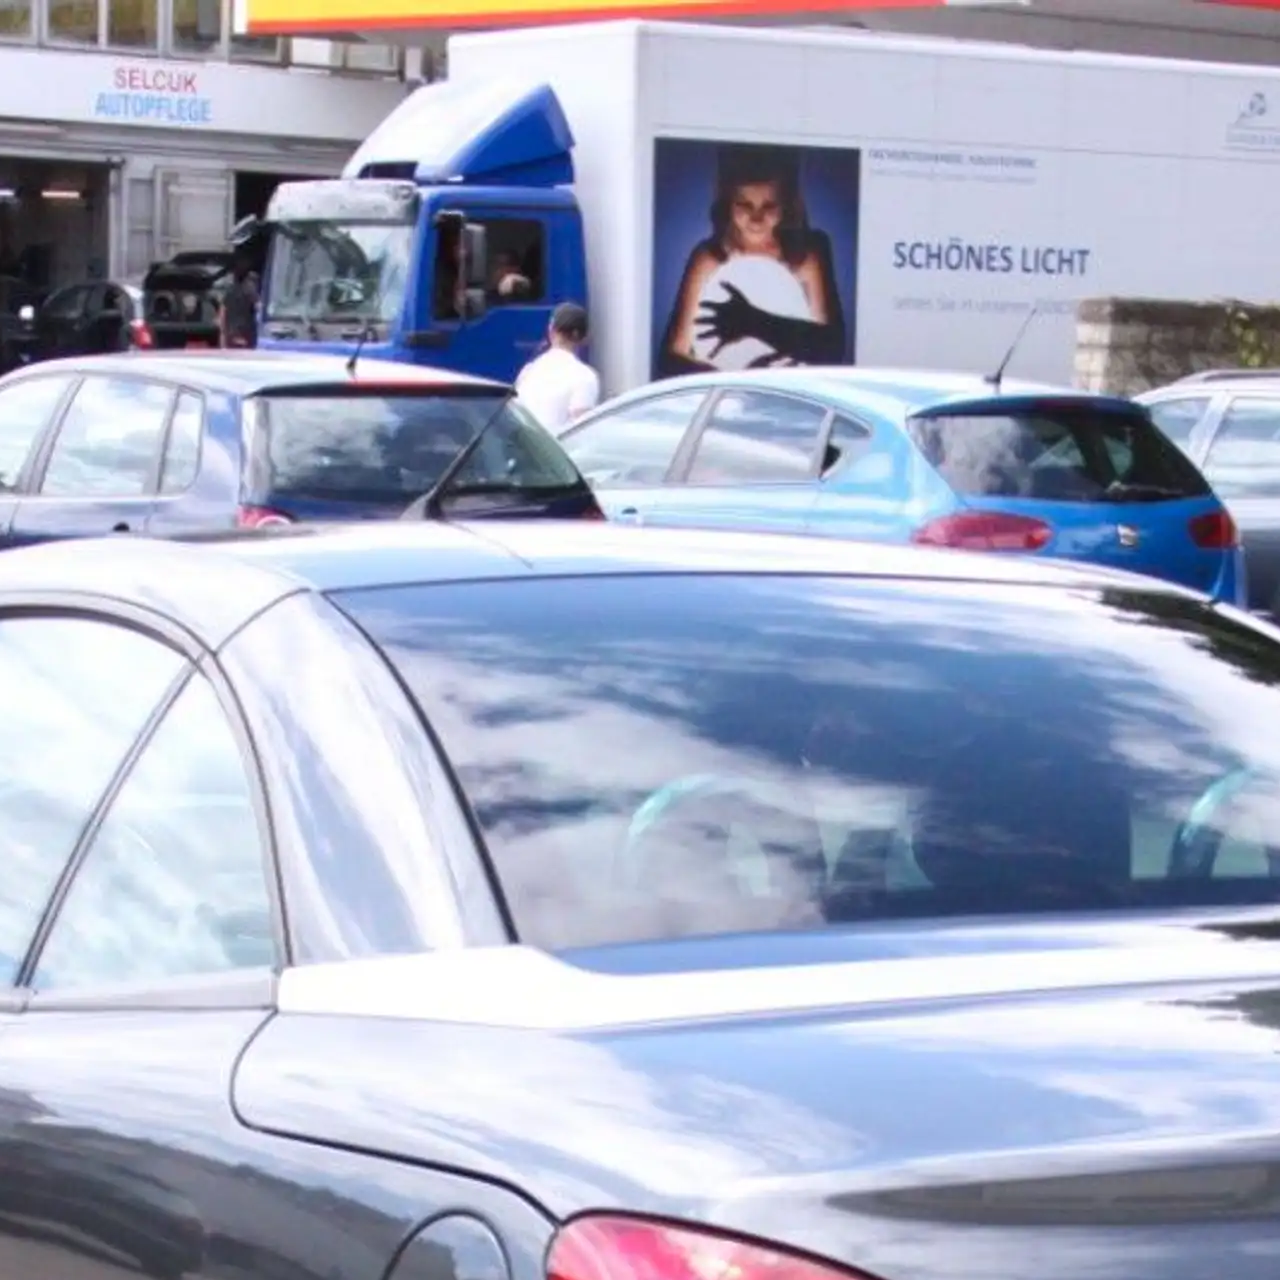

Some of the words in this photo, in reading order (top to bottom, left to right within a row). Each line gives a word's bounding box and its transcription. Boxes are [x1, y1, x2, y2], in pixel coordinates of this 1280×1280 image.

[114, 67, 197, 93] SELCUK
[95, 92, 213, 122] AUTOPFLEGE
[892, 236, 1013, 273] SCHÖNES
[1021, 247, 1091, 275] LICHT
